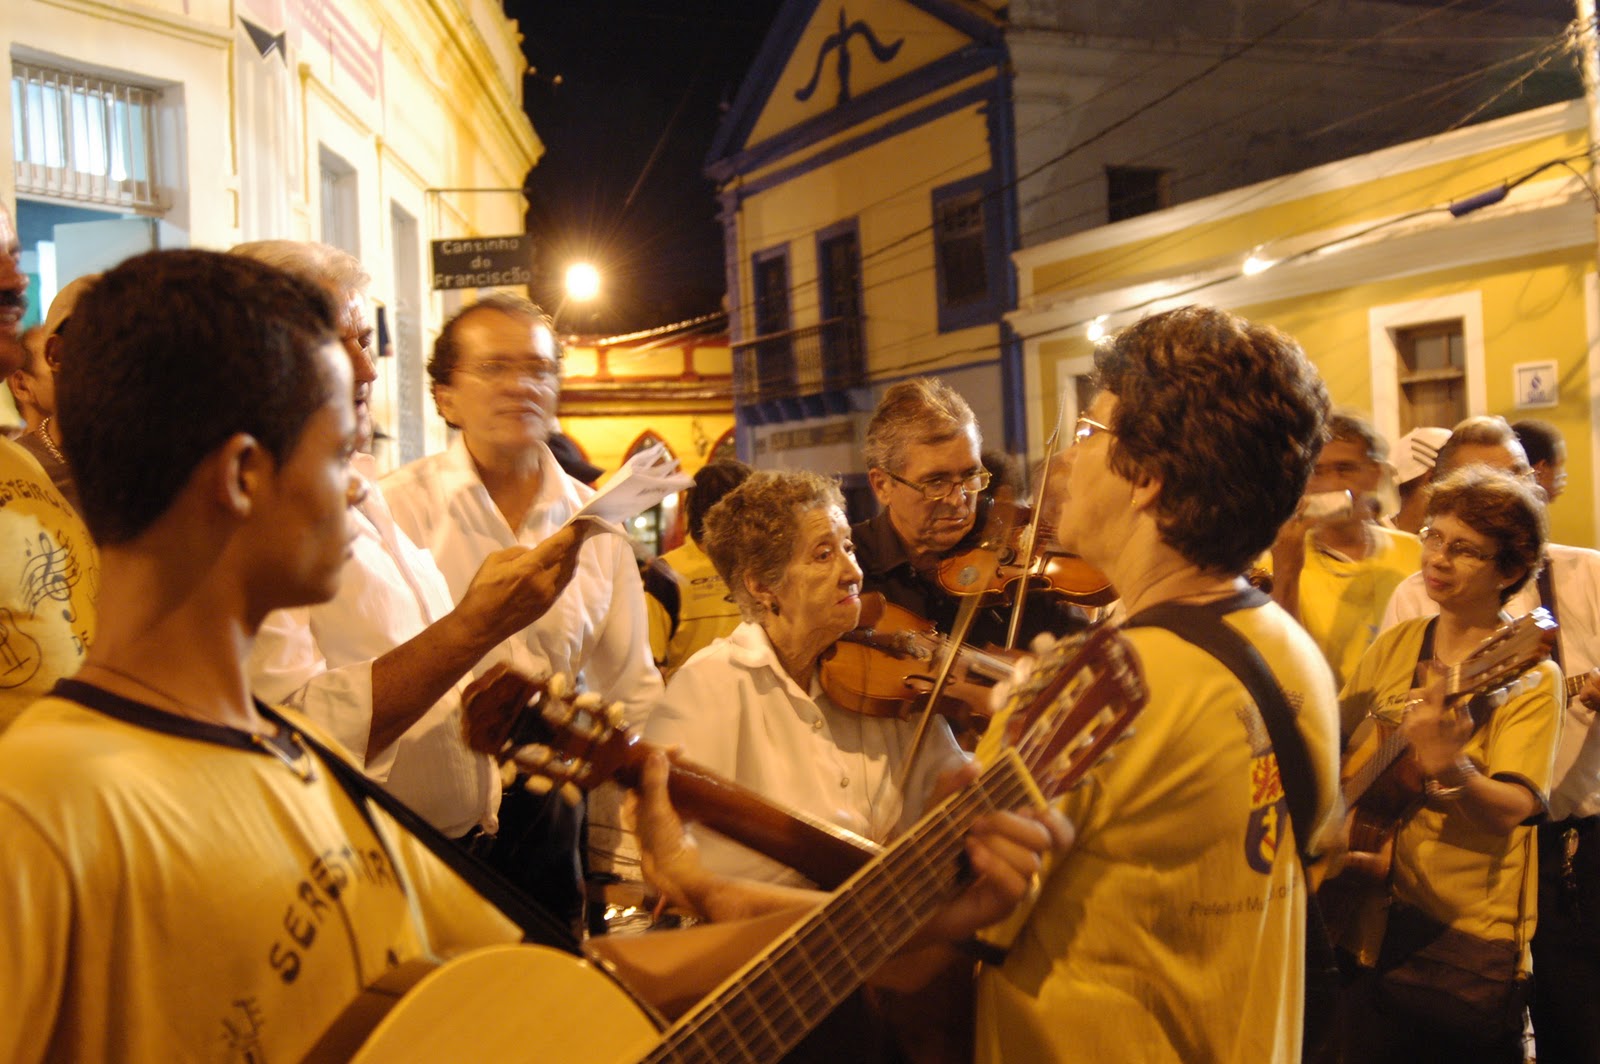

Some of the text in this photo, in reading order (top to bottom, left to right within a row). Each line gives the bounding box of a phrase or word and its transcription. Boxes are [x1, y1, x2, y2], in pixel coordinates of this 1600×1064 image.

[441, 239, 519, 254] Cantinho
[471, 256, 492, 268] do
[435, 266, 532, 287] Franciscão
